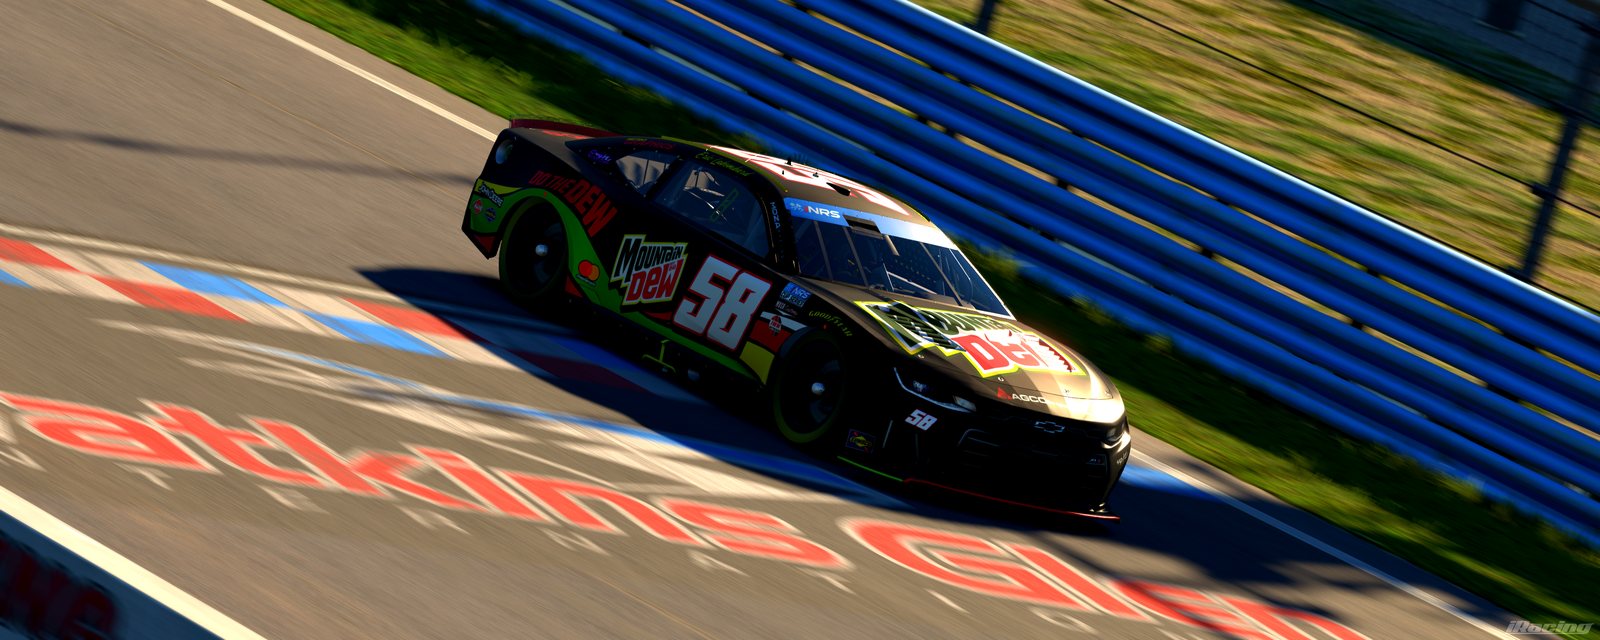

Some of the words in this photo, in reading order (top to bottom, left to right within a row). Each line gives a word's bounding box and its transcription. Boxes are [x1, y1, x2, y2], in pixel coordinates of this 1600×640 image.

[528, 171, 553, 186] DO
[545, 174, 576, 195] THE
[563, 178, 619, 238] DEW
[769, 201, 781, 229] MOZA
[806, 205, 841, 219] NRS
[672, 253, 773, 353] 58
[1011, 393, 1047, 404] AGCO
[904, 408, 939, 431] 58
[838, 513, 1373, 640] Glen
